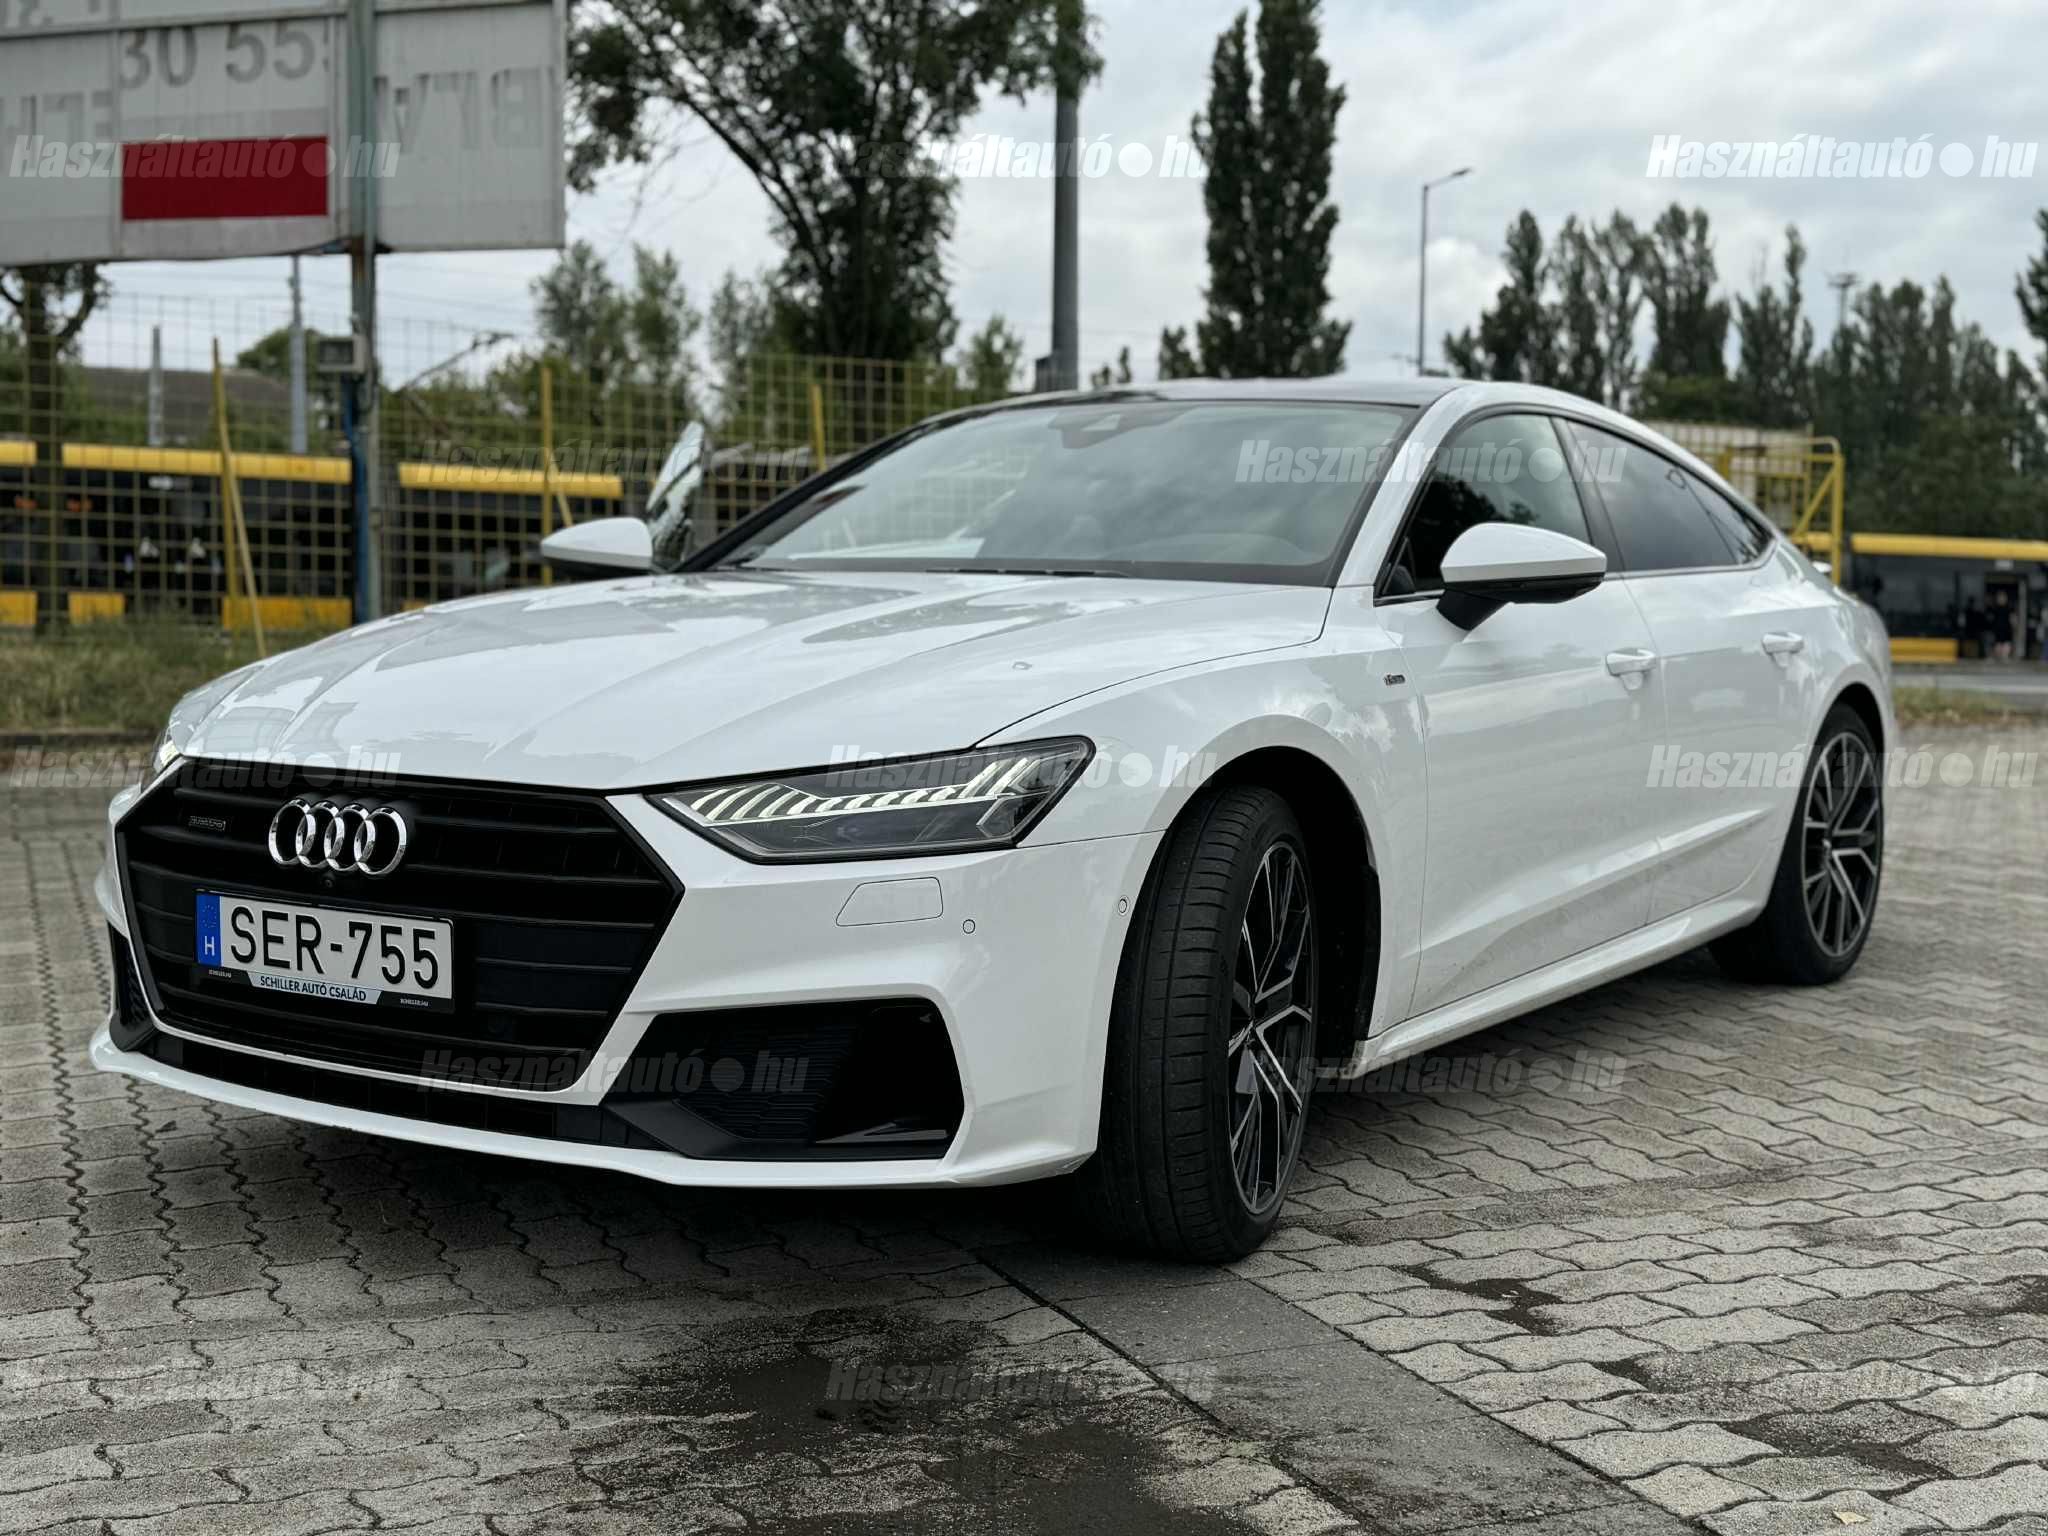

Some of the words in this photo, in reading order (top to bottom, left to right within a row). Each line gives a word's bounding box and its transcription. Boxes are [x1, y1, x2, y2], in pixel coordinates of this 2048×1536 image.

[204, 935, 215, 957] H
[230, 905, 439, 990] SER-755
[260, 975, 301, 992] SCHILLER
[301, 982, 327, 996] AUTÓ
[329, 983, 367, 1001] CSALÁD
